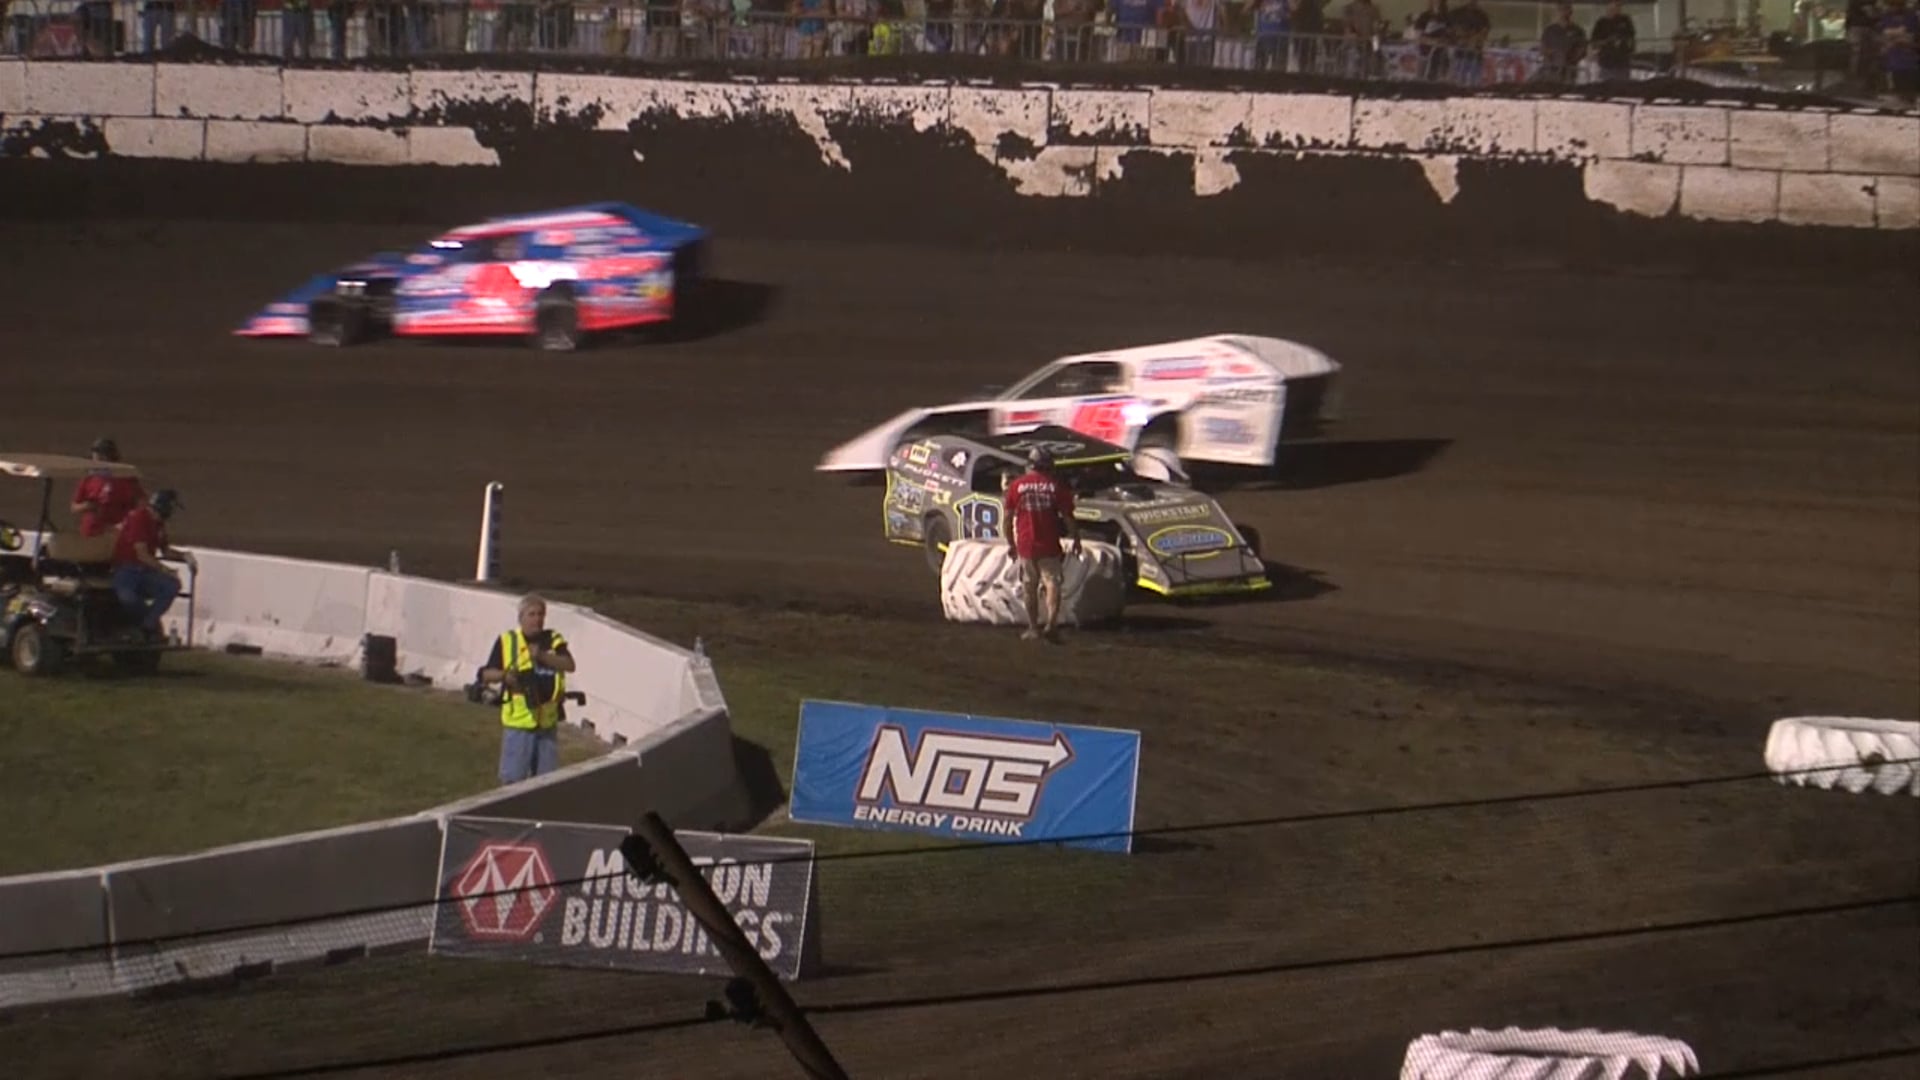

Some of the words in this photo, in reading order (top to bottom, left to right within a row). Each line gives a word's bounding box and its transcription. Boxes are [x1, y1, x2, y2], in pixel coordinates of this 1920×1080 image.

[960, 494, 1003, 540] 18
[857, 724, 1074, 817] NOS
[853, 805, 949, 830] ENERGY
[950, 814, 1026, 837] DRINK
